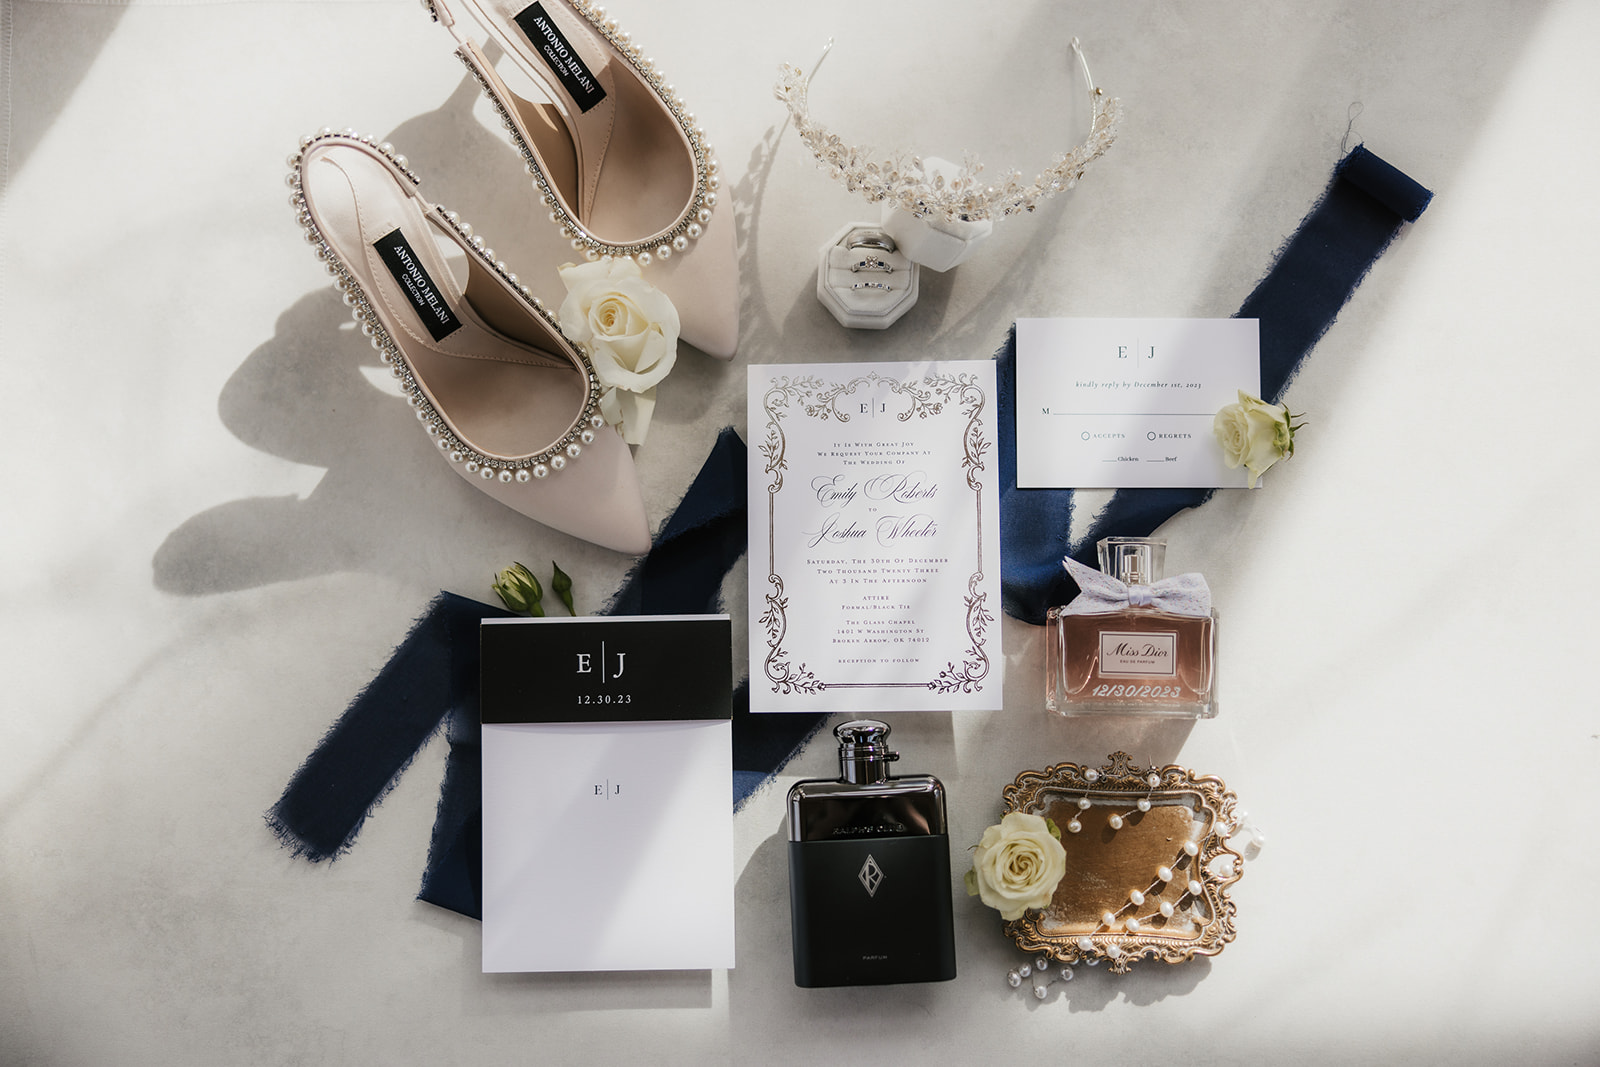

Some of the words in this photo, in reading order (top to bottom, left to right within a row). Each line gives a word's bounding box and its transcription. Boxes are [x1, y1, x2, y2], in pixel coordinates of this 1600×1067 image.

[533, 16, 568, 58] ANTONIO
[565, 56, 594, 94] MELANI
[544, 45, 569, 76] COLLECTION
[394, 246, 426, 287] ANTONIO
[422, 287, 449, 324] MELANI
[402, 274, 426, 306] COLLECTION
[1118, 346, 1128, 359] E
[1148, 346, 1155, 359] J
[860, 403, 868, 413] E
[880, 403, 886, 413] J
[810, 474, 858, 508] Emily
[864, 470, 938, 504] Roberts
[801, 512, 867, 548] Joshua
[876, 513, 938, 547] Wheeler
[1106, 643, 1139, 657] Miss
[1142, 644, 1168, 657] Dior
[577, 654, 592, 673] E
[613, 653, 626, 678] J
[578, 695, 632, 704] 12.30.23
[1092, 684, 1181, 697] 12/30/2023
[595, 785, 602, 795] E
[615, 785, 620, 794] J
